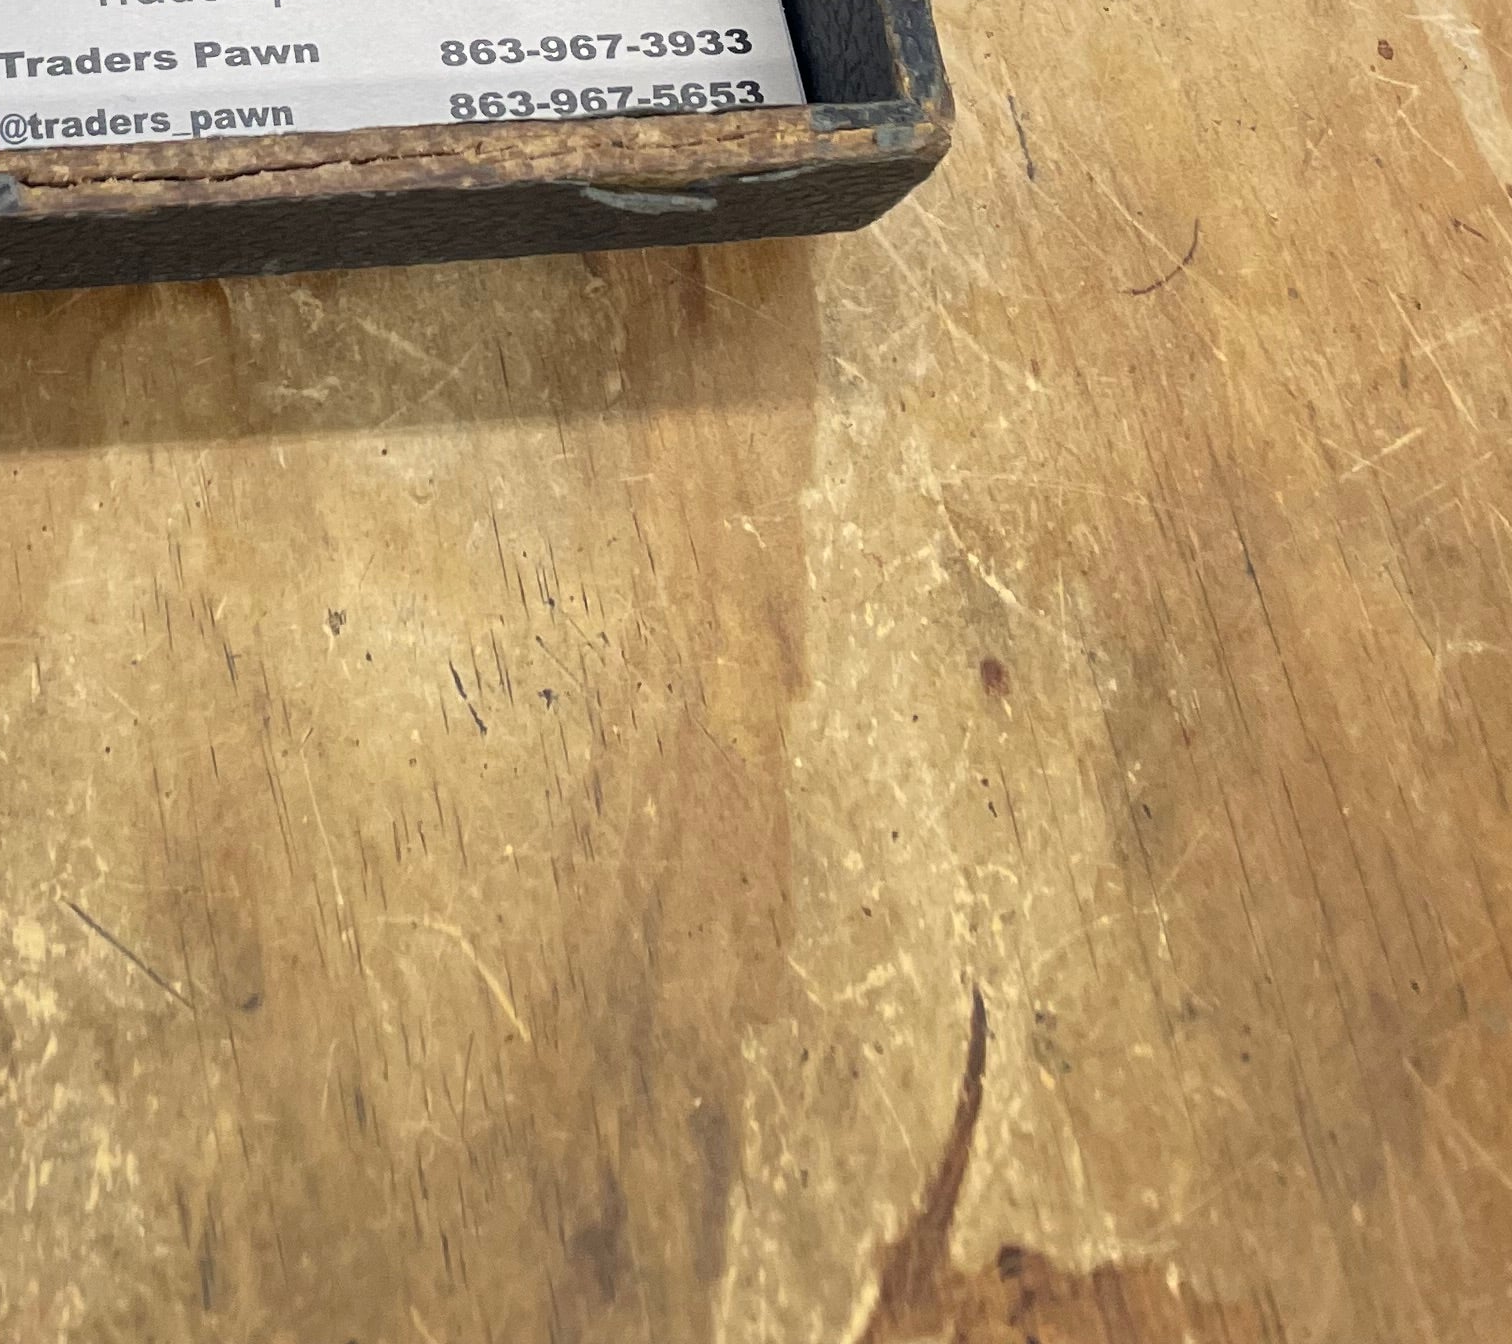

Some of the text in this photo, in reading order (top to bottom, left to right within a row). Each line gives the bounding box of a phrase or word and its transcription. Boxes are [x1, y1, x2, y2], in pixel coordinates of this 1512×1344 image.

[193, 40, 321, 70] Pawn
[439, 28, 754, 67] 863-967-3933
[448, 80, 765, 122] 863-967-5653
[0, 105, 295, 146] @traders_pawn
